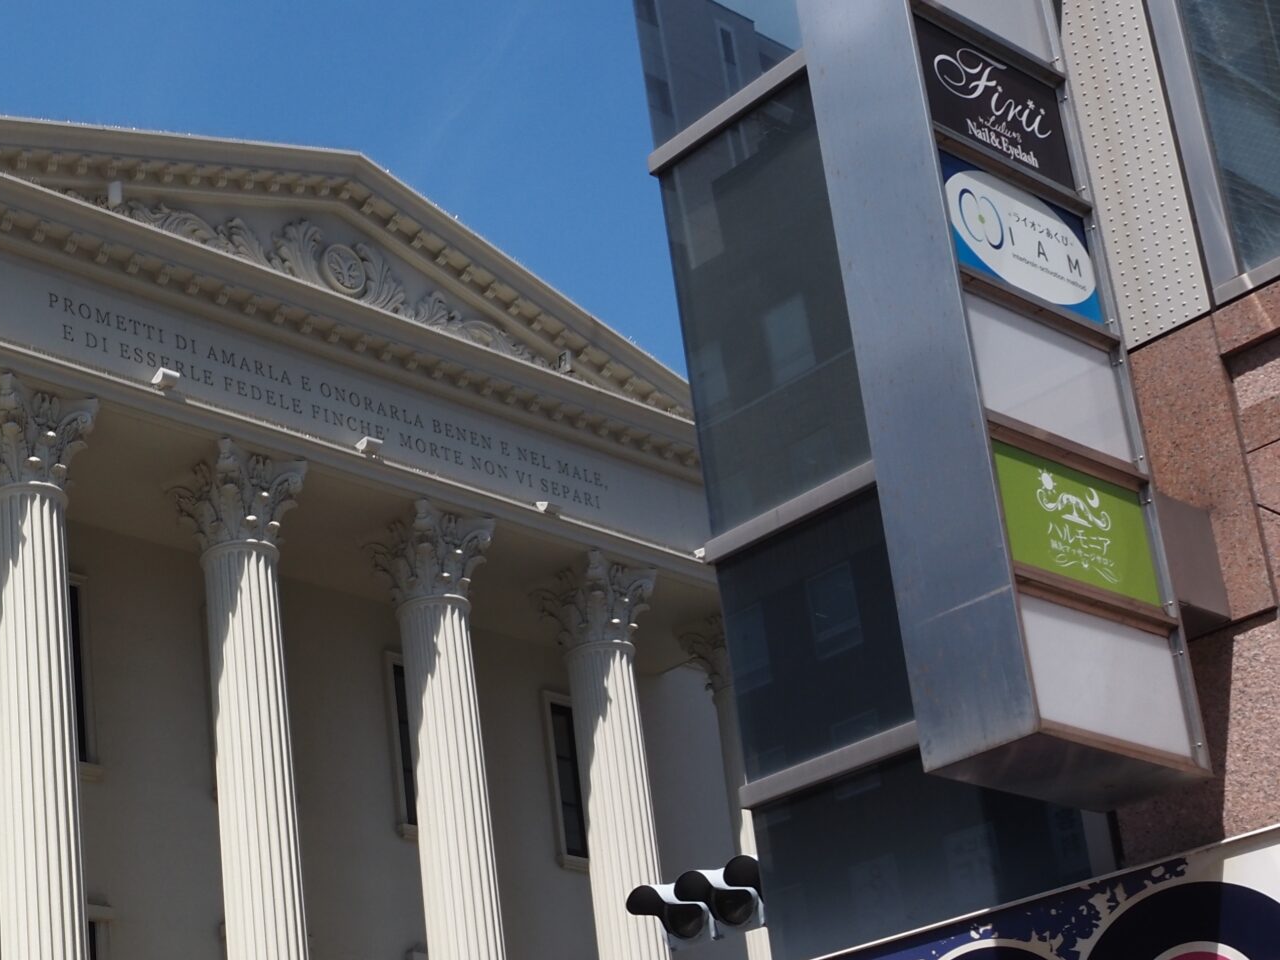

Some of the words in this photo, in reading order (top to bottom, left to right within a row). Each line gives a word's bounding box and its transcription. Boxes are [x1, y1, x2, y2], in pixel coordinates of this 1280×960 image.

[48, 292, 165, 344] PROMETTI
[175, 334, 196, 355] DI
[206, 346, 292, 386] AMARLA
[301, 375, 312, 392] E
[319, 382, 425, 430] ONORARLA
[432, 419, 493, 451] BENEN
[500, 440, 510, 457] E
[517, 447, 551, 470] NEL
[557, 459, 609, 491] MALE,
[63, 324, 74, 342] E
[85, 332, 108, 353] DI
[223, 376, 303, 415] FEDELE
[399, 432, 465, 466] MORTE
[471, 455, 508, 478] NON
[515, 470, 533, 488] VI
[540, 478, 601, 510] SEPARI
[1047, 521, 1111, 554] ハルモニア
